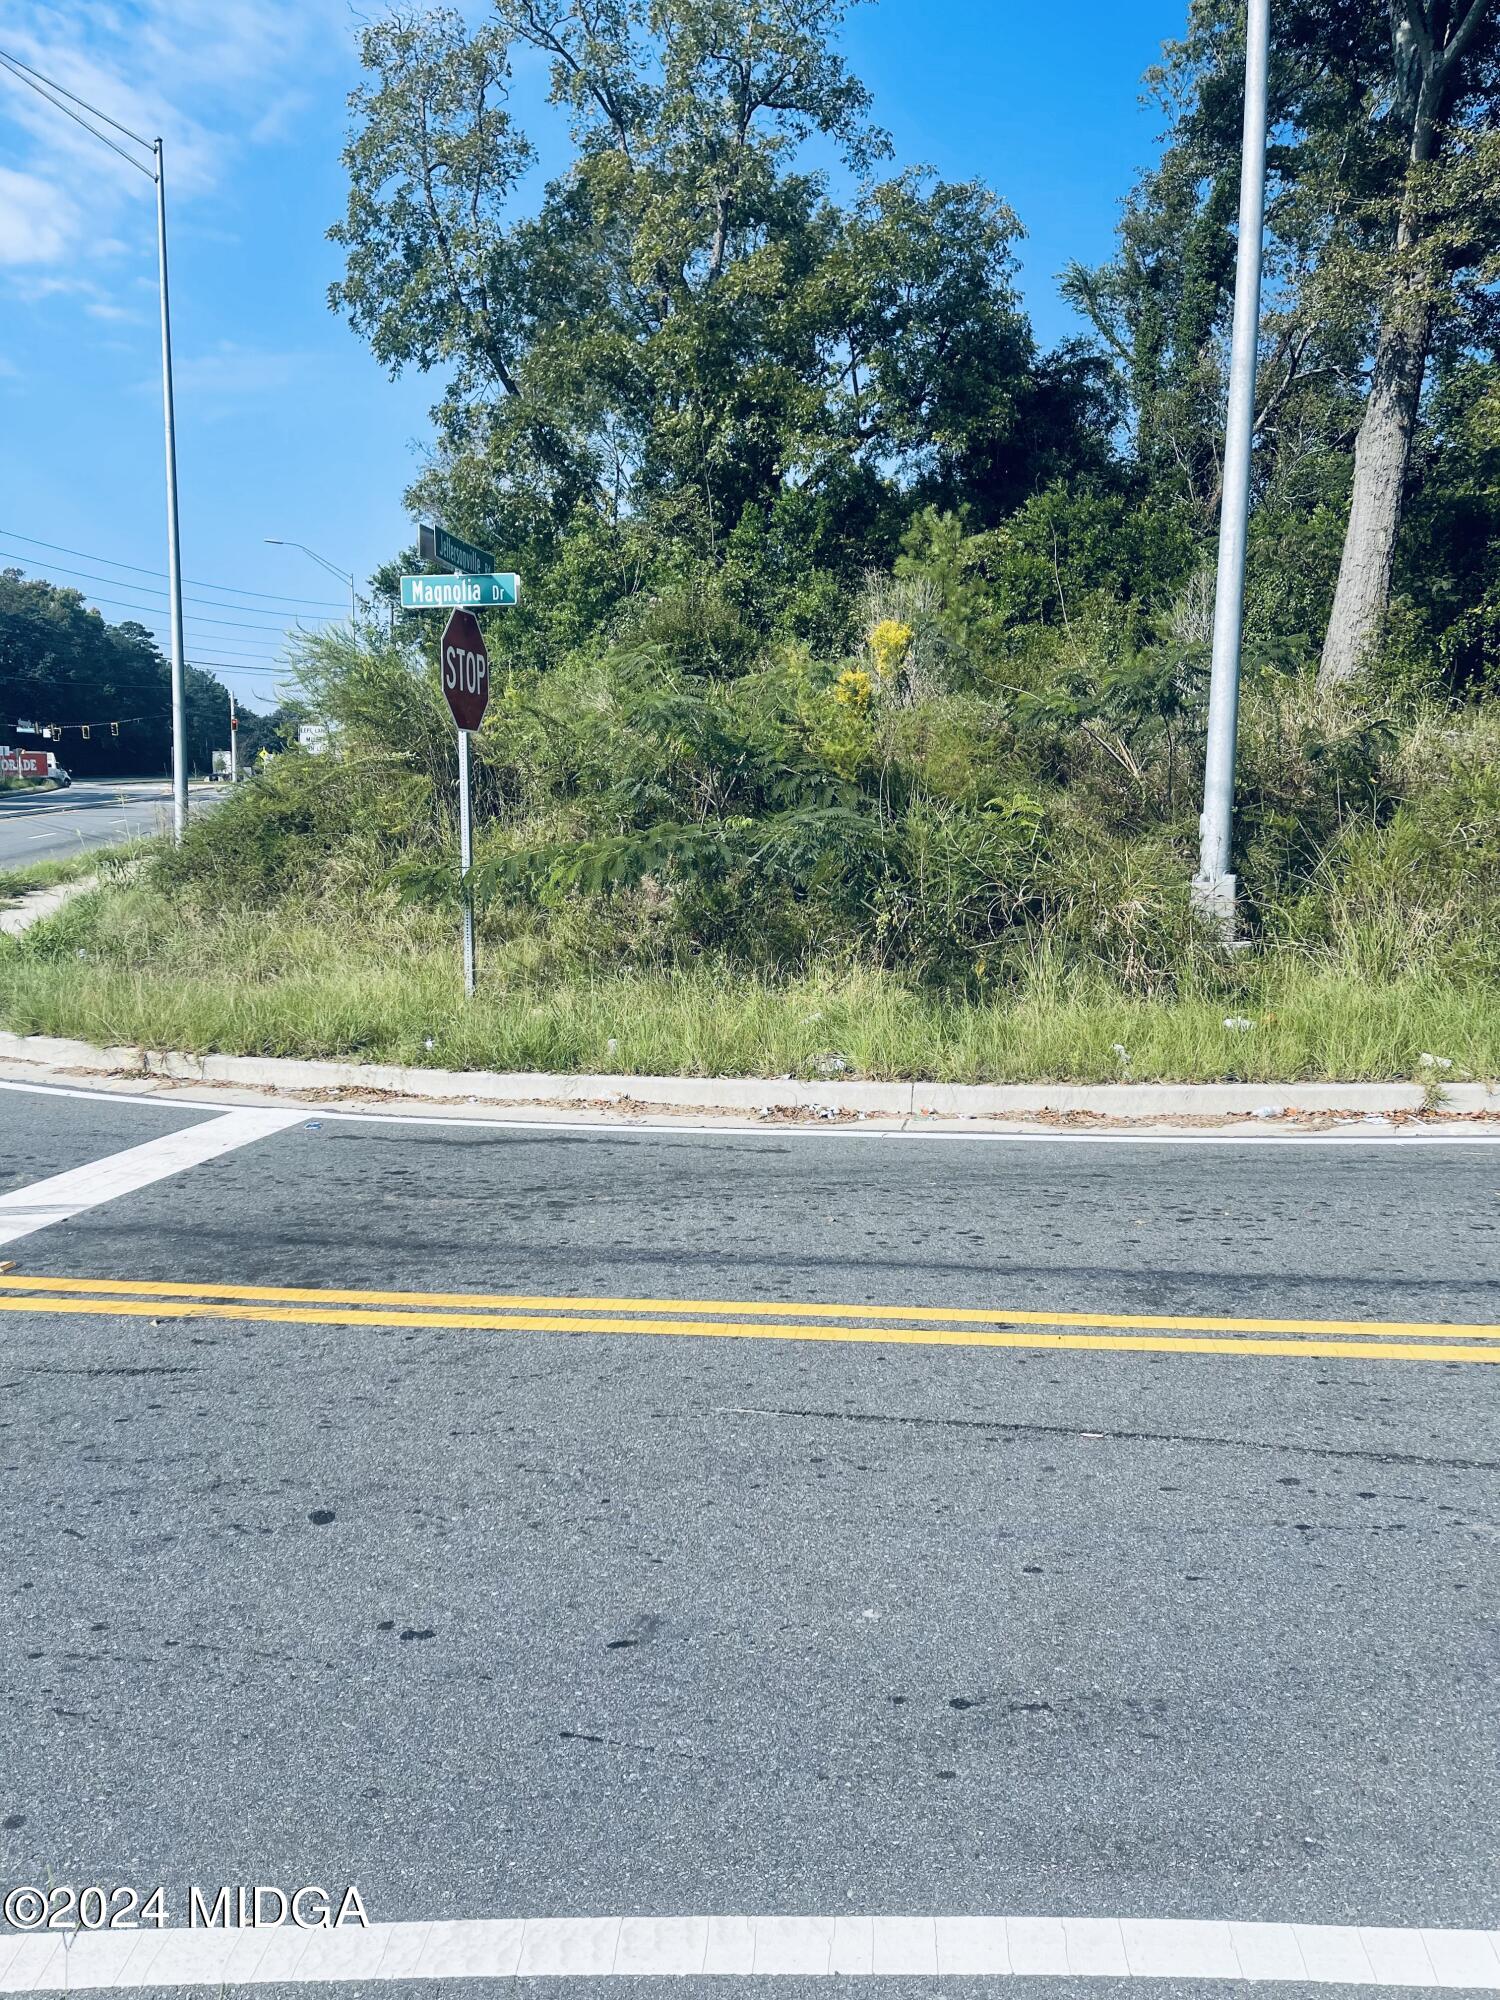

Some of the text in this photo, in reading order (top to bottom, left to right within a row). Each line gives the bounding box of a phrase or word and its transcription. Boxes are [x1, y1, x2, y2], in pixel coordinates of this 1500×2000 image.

[440, 533, 481, 574] Jeffersonville
[411, 579, 505, 604] Magnolia Dr
[446, 646, 486, 695] STOP
